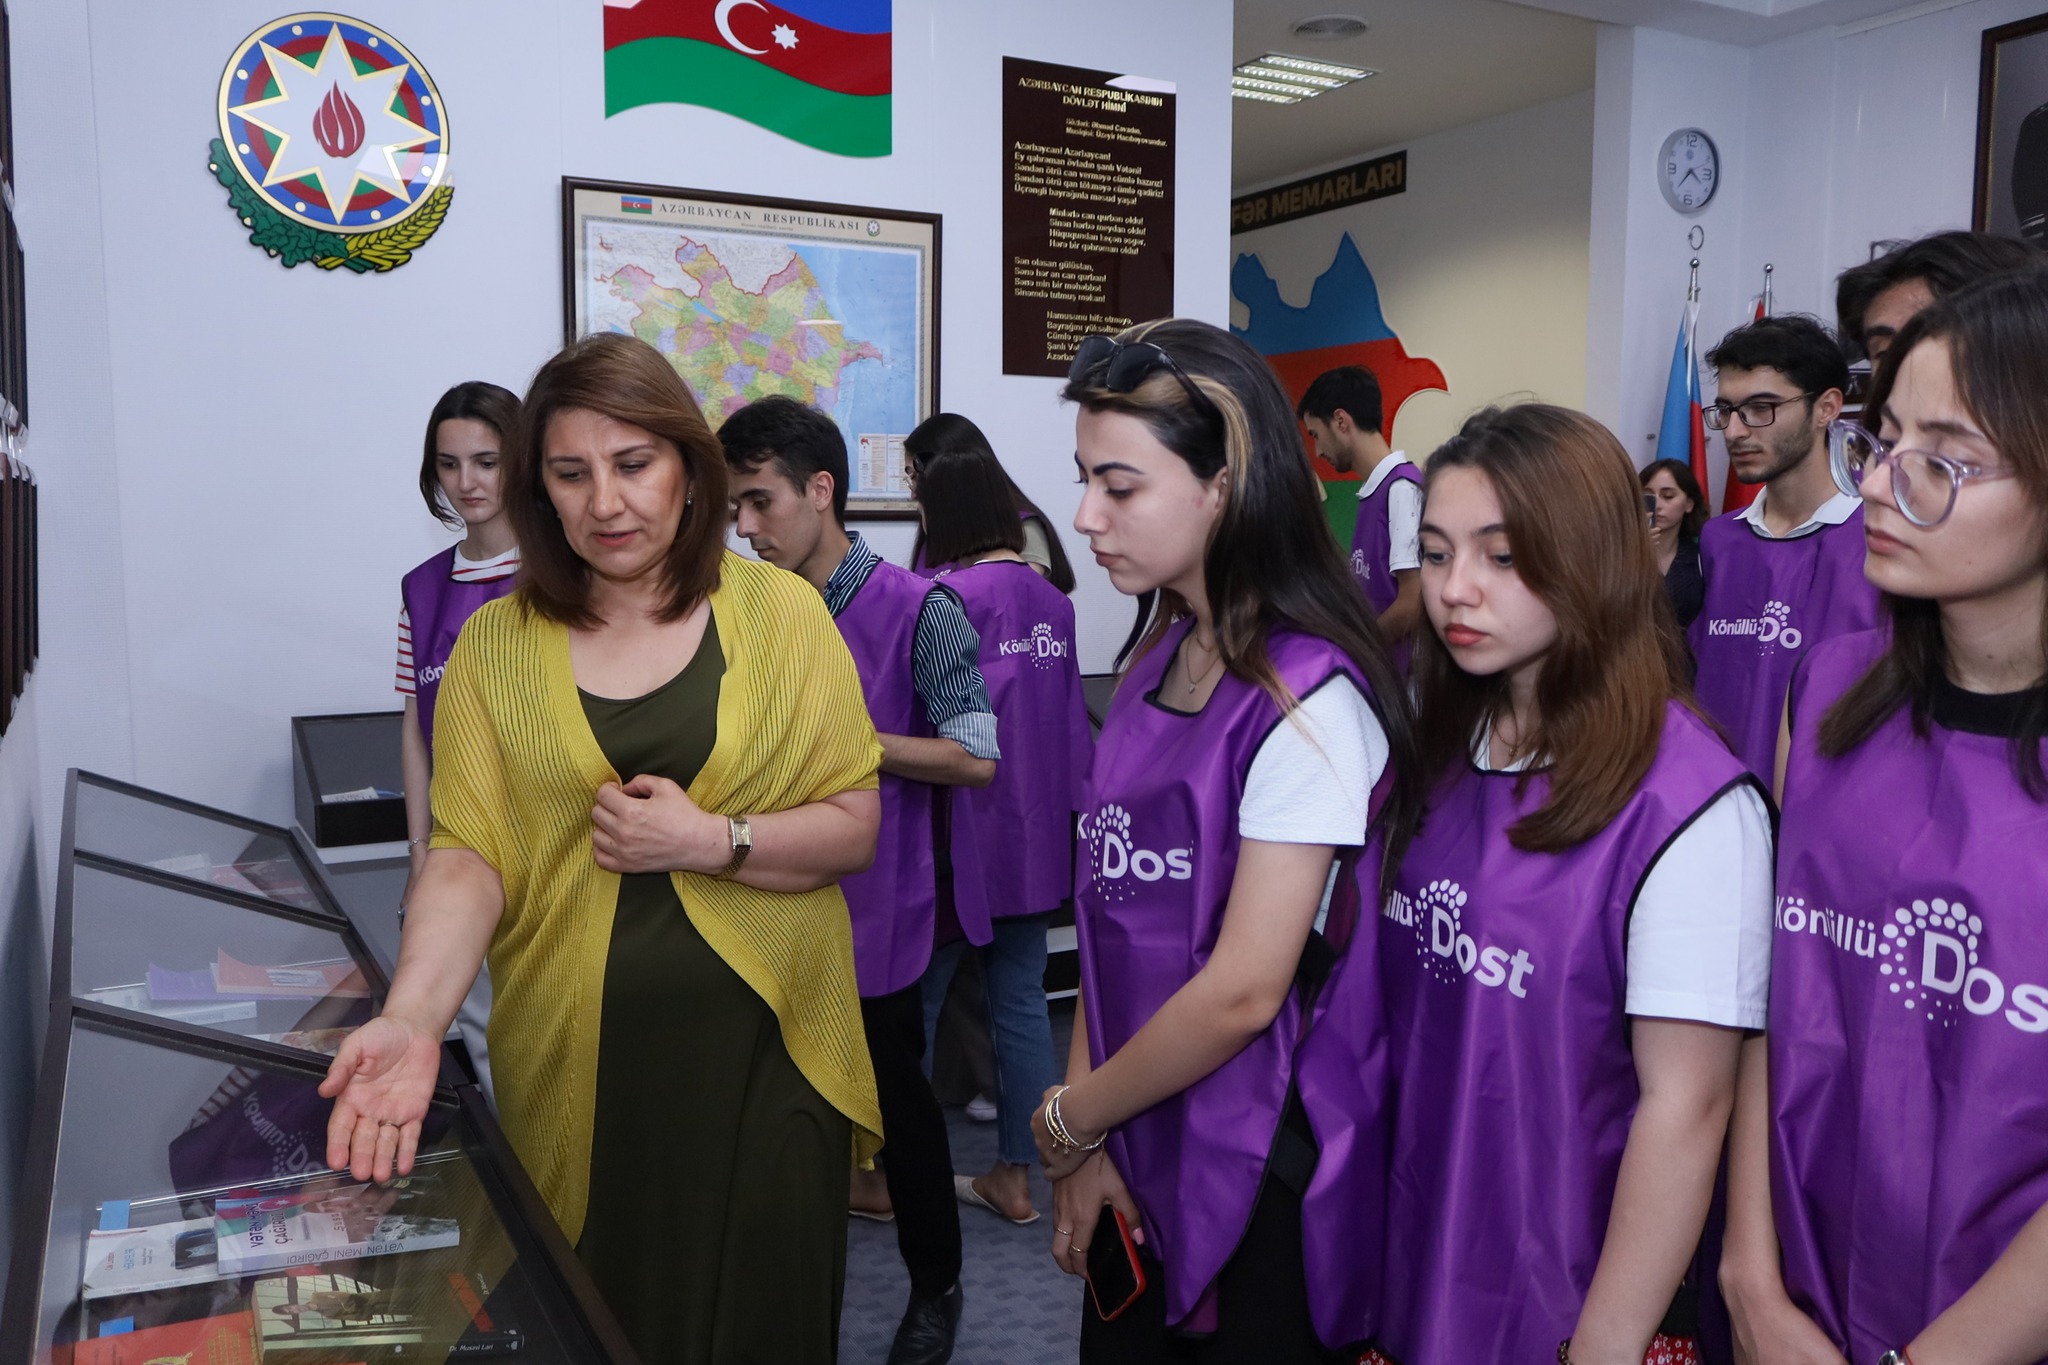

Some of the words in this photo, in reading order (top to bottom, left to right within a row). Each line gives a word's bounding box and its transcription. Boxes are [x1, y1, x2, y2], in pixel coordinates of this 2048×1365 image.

[1018, 77, 1082, 95] AZƏRBAYCAN
[1062, 95, 1099, 109] DÖVLƏT
[1101, 100, 1127, 113] HİMNİ
[1686, 133, 1698, 148] 12
[1014, 141, 1063, 155] Azərbaycan!
[1064, 147, 1111, 160] Azərbaycan!
[1014, 152, 1025, 161] Ey
[1026, 153, 1065, 166] qəhrəman
[1014, 163, 1044, 174] Səndən
[1046, 165, 1062, 176] ötrü
[1112, 174, 1136, 184] cümlə
[1014, 174, 1044, 184] Səndən
[1046, 176, 1062, 186] ötrü
[1063, 180, 1078, 188] qan
[1271, 159, 1403, 218] MEMARLARI
[1683, 194, 1693, 206] 6
[658, 202, 752, 221] AZƏRBAYCAN
[763, 212, 860, 231] RESPUBLİKASI
[1081, 212, 1096, 220] can
[1096, 214, 1124, 223] qurban
[1068, 240, 1080, 249] bir
[1014, 256, 1030, 265] Sən
[1031, 258, 1058, 268] olasan
[1014, 266, 1034, 276] Sənə
[1036, 268, 1050, 277] hər
[1061, 272, 1076, 280] can
[1014, 277, 1034, 286] Sənə
[1052, 280, 1063, 288] bir
[1046, 331, 1072, 340] Cümlə
[1046, 341, 1066, 351] Şanlı
[1708, 618, 1758, 636] Könüllü
[1757, 616, 1802, 650] Do
[1102, 831, 1194, 882] Dos
[1431, 904, 1535, 999] Dost
[333, 1247, 363, 1260] MƏNİ
[367, 1242, 404, 1255] VƏTƏN
